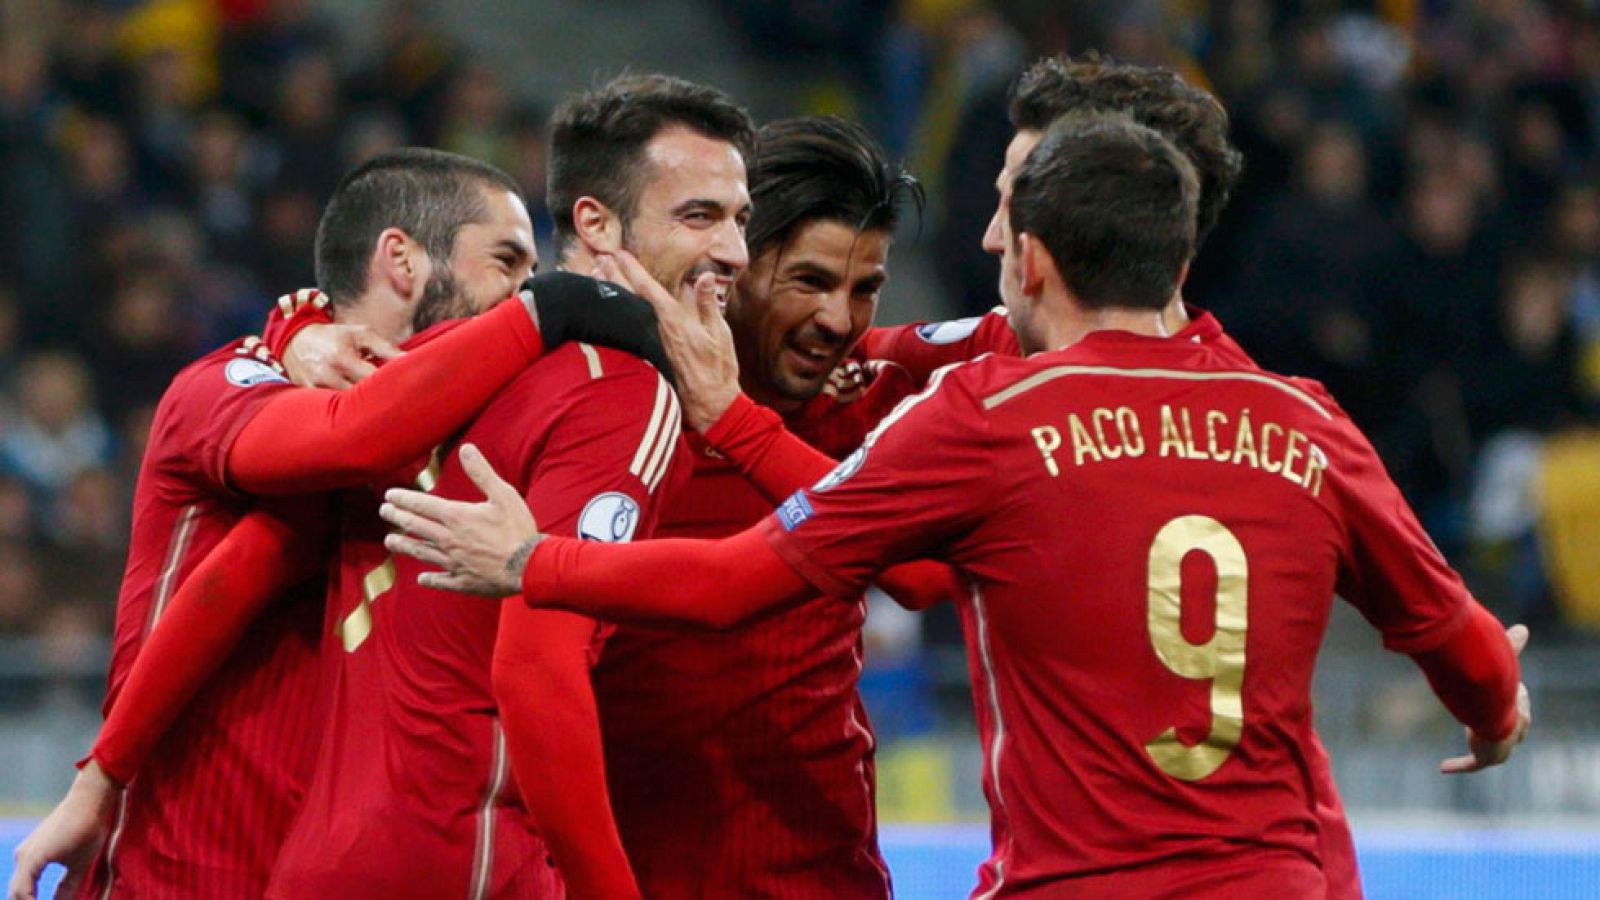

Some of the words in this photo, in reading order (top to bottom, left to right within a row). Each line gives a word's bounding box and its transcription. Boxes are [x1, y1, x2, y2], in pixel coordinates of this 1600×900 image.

[1031, 406, 1146, 477] PACO
[1158, 404, 1330, 498] ALCÁCER
[1145, 514, 1248, 781] 9
